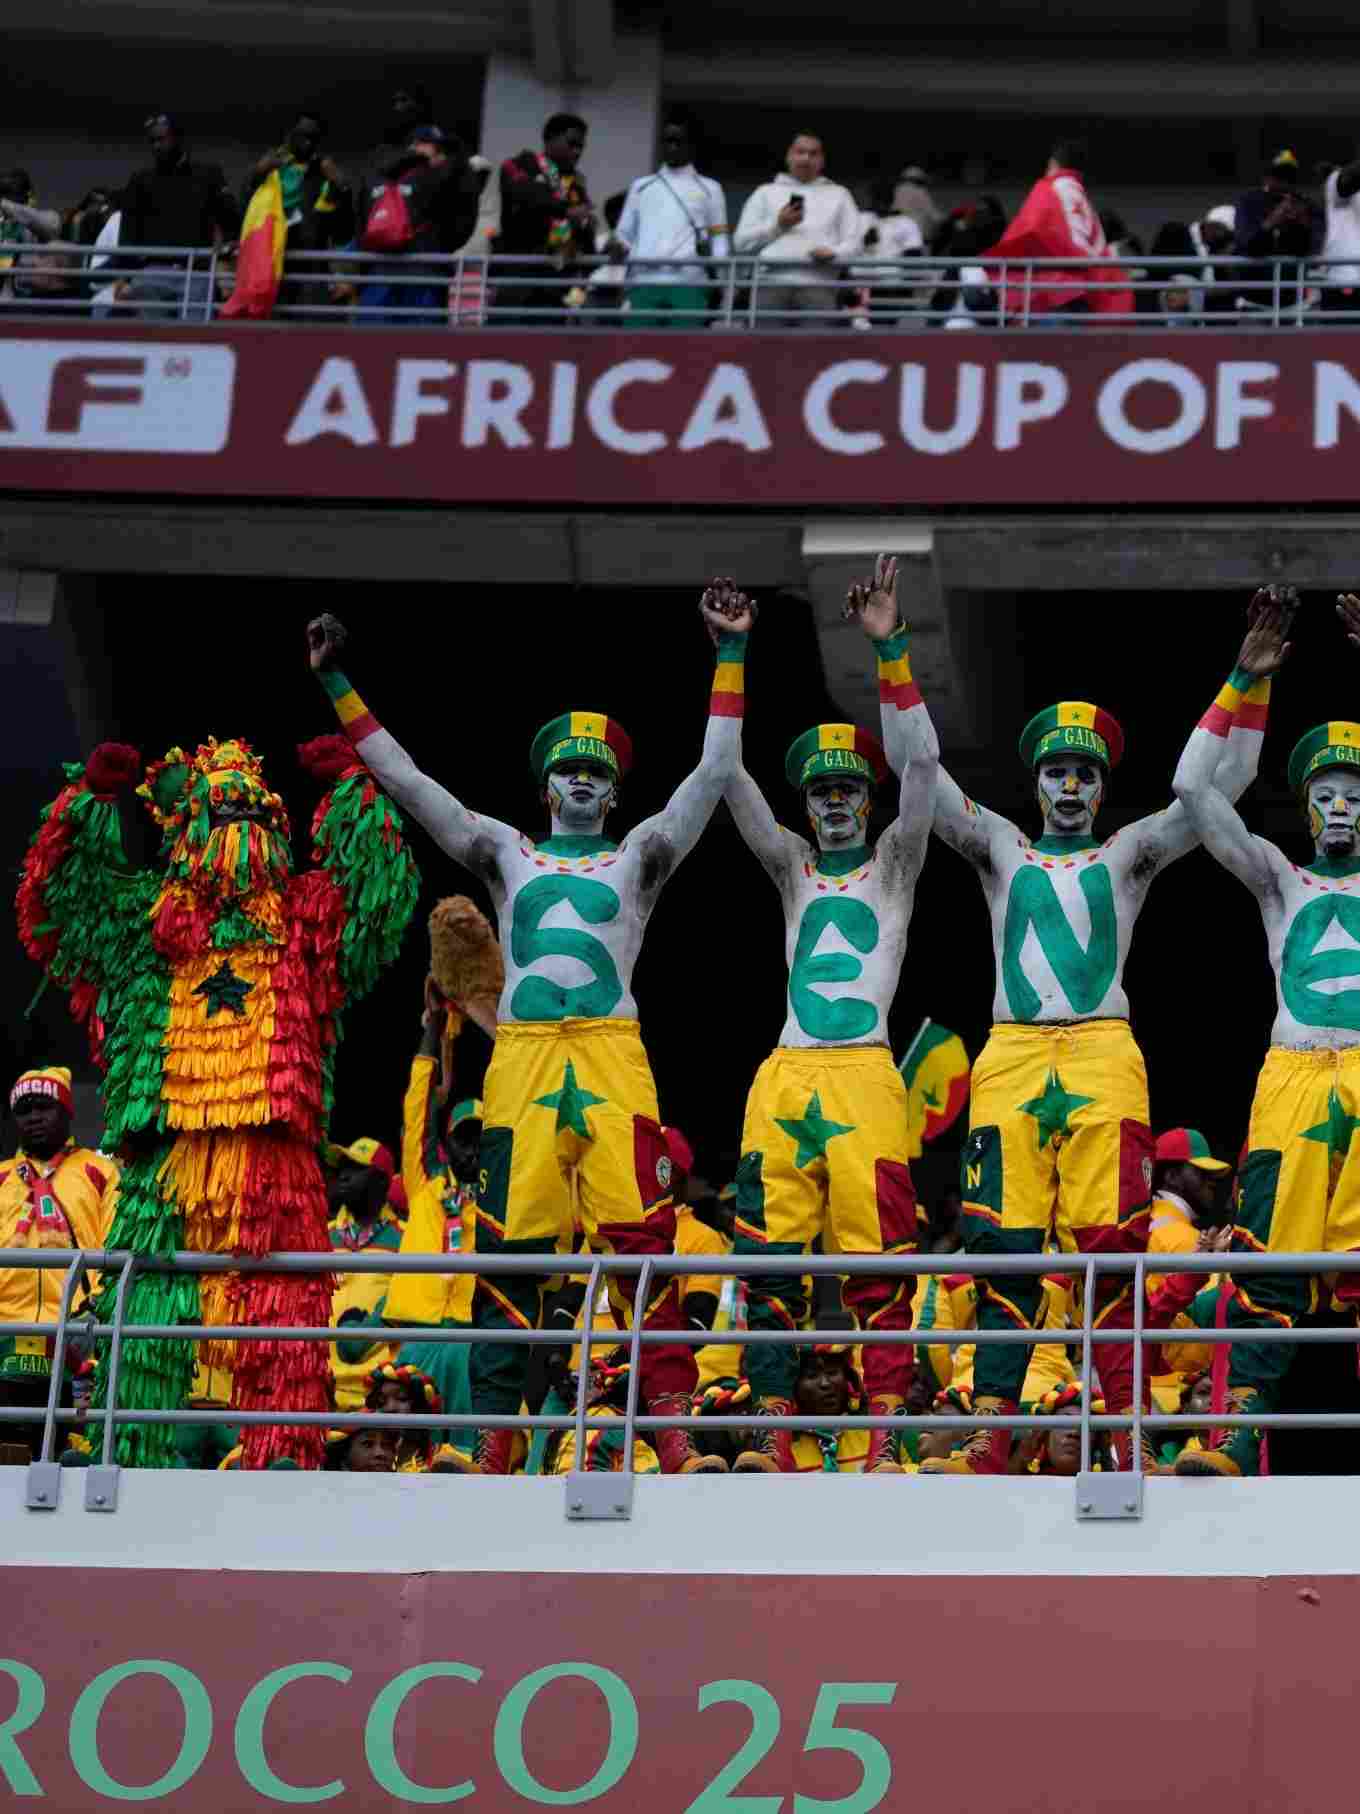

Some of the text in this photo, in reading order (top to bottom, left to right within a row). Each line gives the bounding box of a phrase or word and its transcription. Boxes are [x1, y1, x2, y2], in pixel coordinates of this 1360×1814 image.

[286, 357, 773, 454] AFRICA
[803, 359, 1068, 454] CUP
[1097, 358, 1279, 453] OF
[683, 1680, 898, 1814] 25
